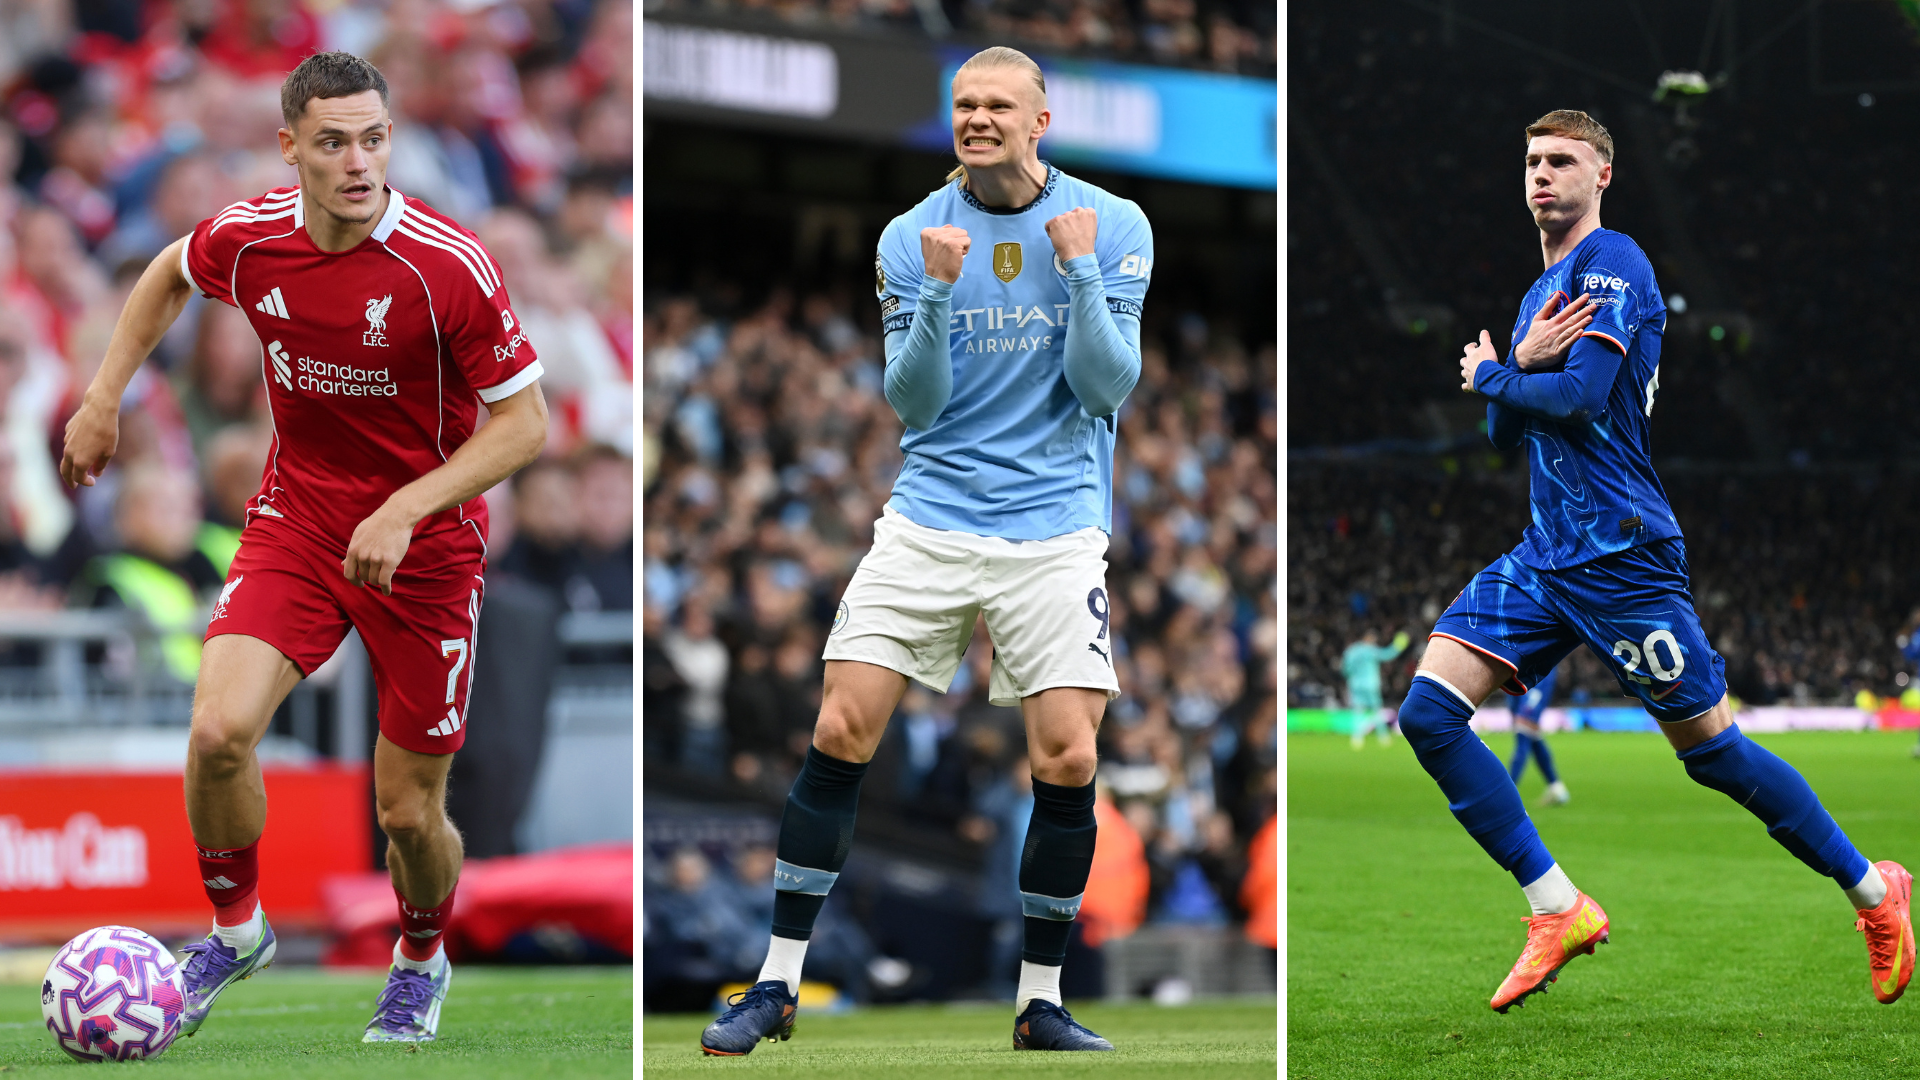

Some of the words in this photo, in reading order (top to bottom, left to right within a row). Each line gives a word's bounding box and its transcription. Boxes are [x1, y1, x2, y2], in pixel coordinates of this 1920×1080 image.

[1583, 274, 1630, 293] fever
[965, 335, 1052, 353] AIRWAYS
[297, 356, 389, 382] standard
[298, 374, 398, 396] chartered
[1087, 587, 1109, 640] 9
[440, 637, 468, 706] 7
[1612, 629, 1685, 685] 20
[1560, 902, 1606, 956] NIKE
